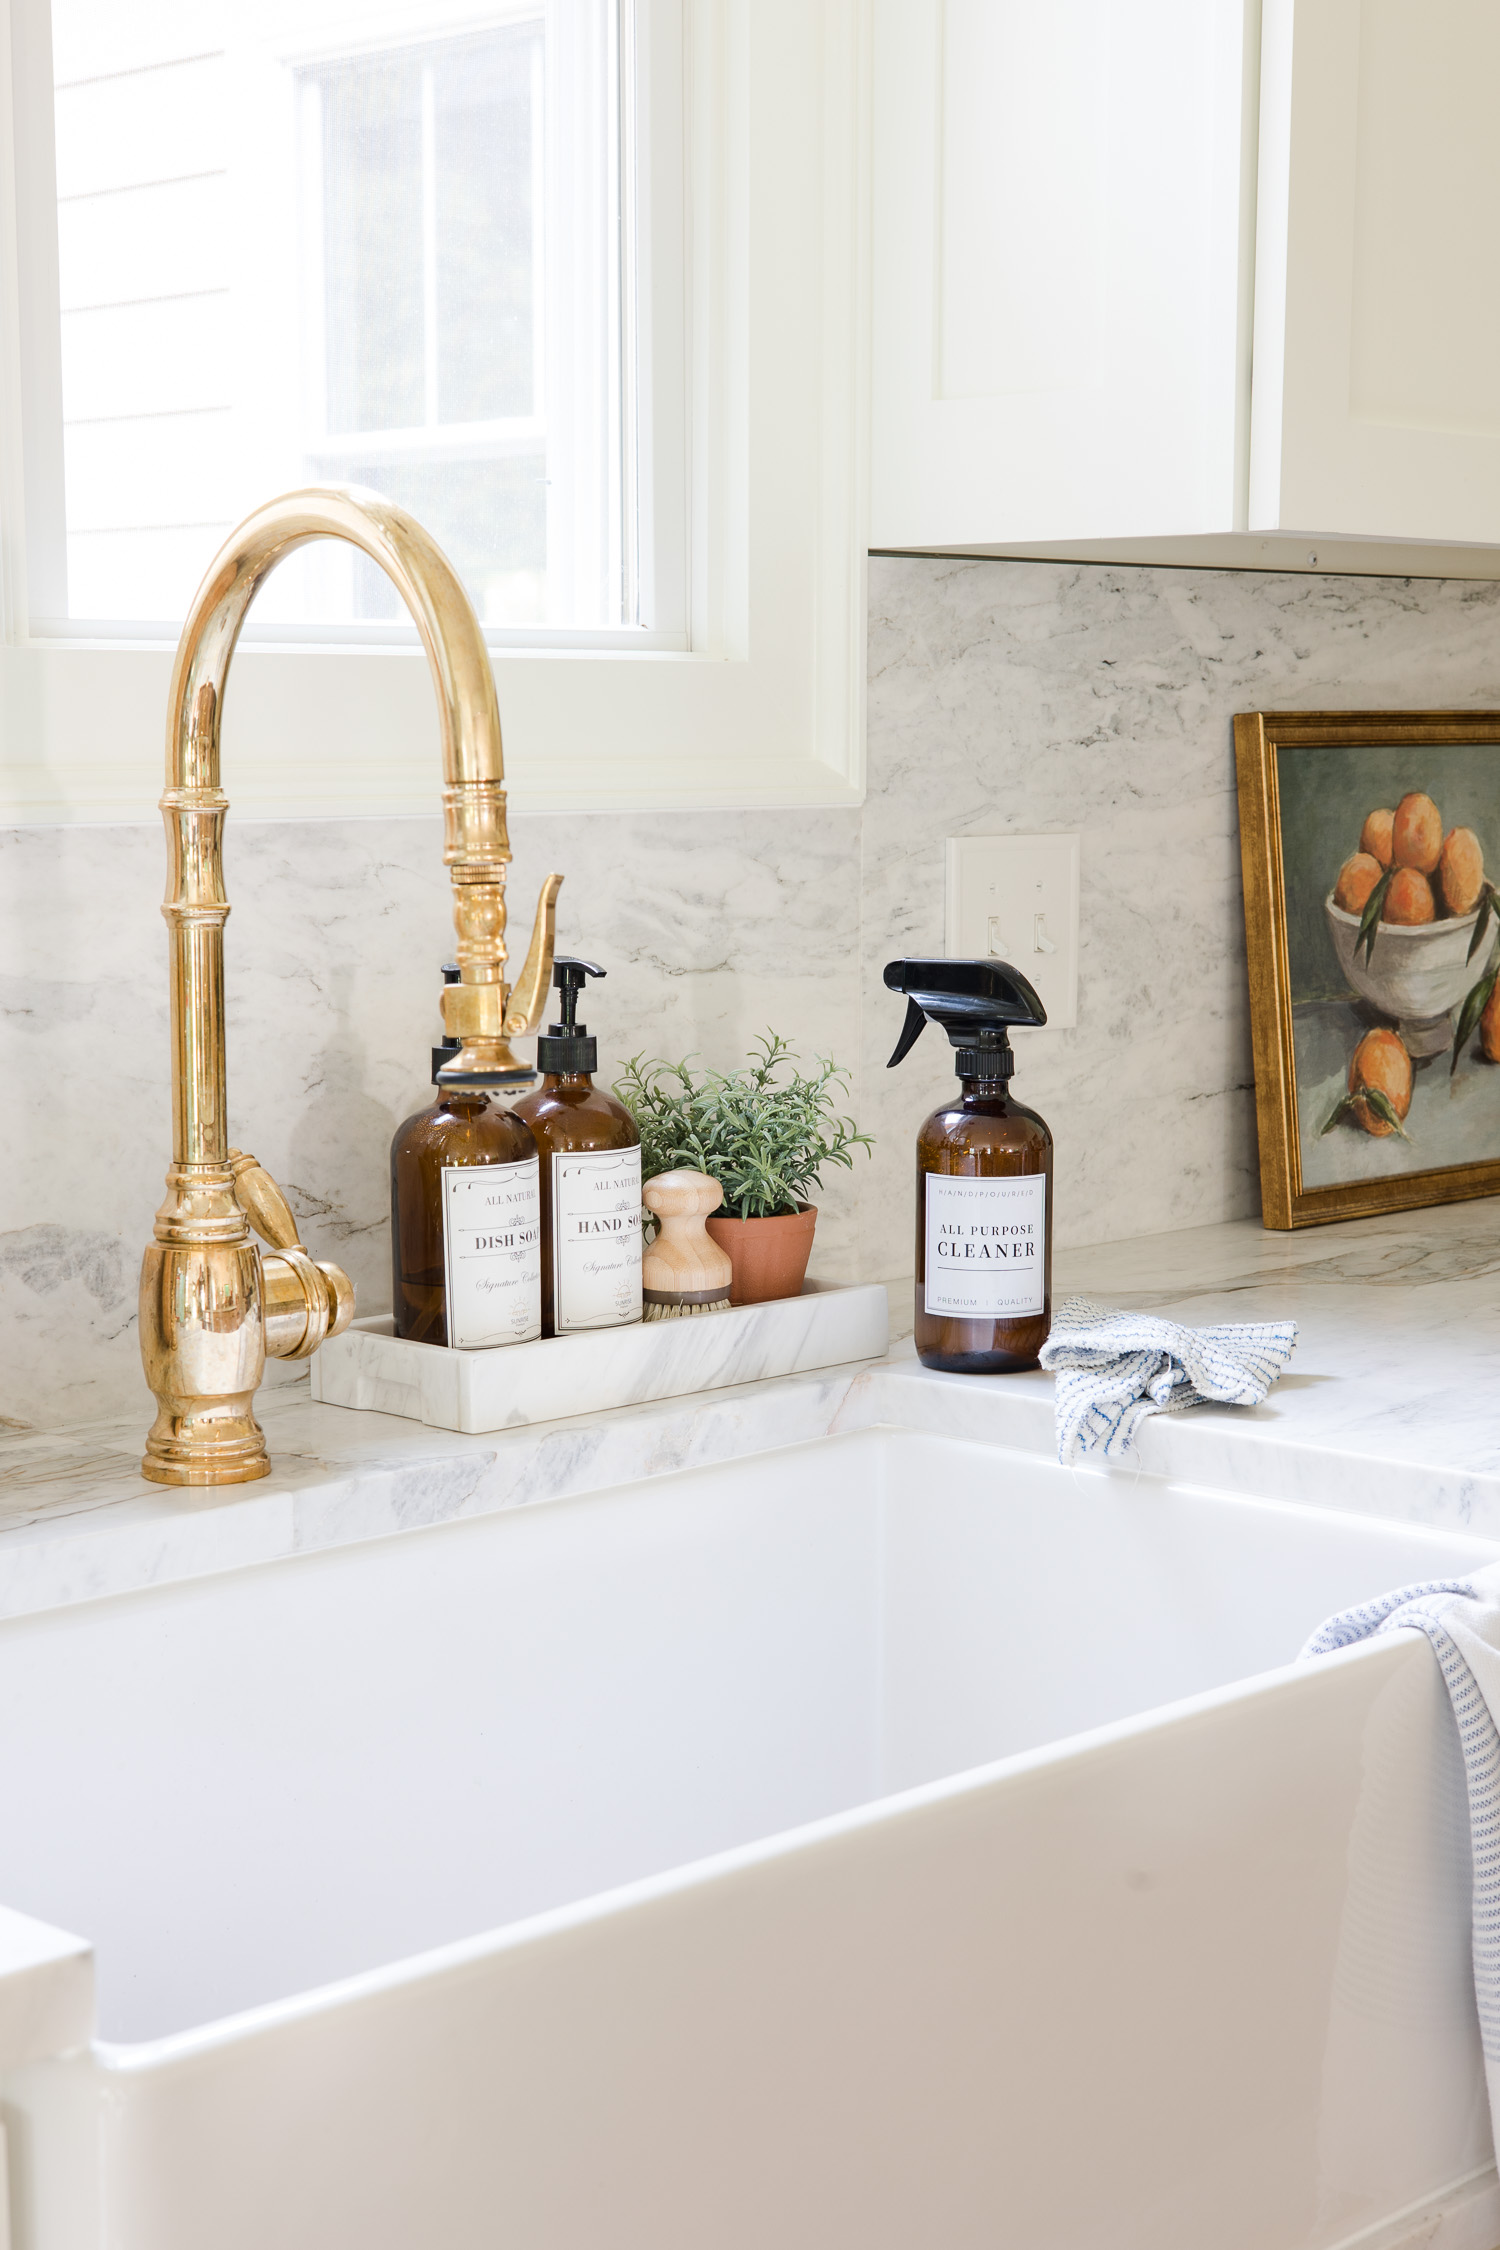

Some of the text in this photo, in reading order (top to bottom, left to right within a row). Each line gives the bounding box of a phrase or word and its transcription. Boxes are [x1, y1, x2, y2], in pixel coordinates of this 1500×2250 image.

[593, 1179, 612, 1191] ALL
[484, 1196, 505, 1207] ALL
[577, 1217, 622, 1234] HAND
[939, 1223, 1035, 1237] ALL PURPOSE
[474, 1232, 515, 1250] DISH
[937, 1241, 1036, 1259] CLEANER
[582, 1260, 623, 1277] Signature
[475, 1277, 519, 1294] Signature
[937, 1296, 1033, 1306] PREMIUM QUALITY
